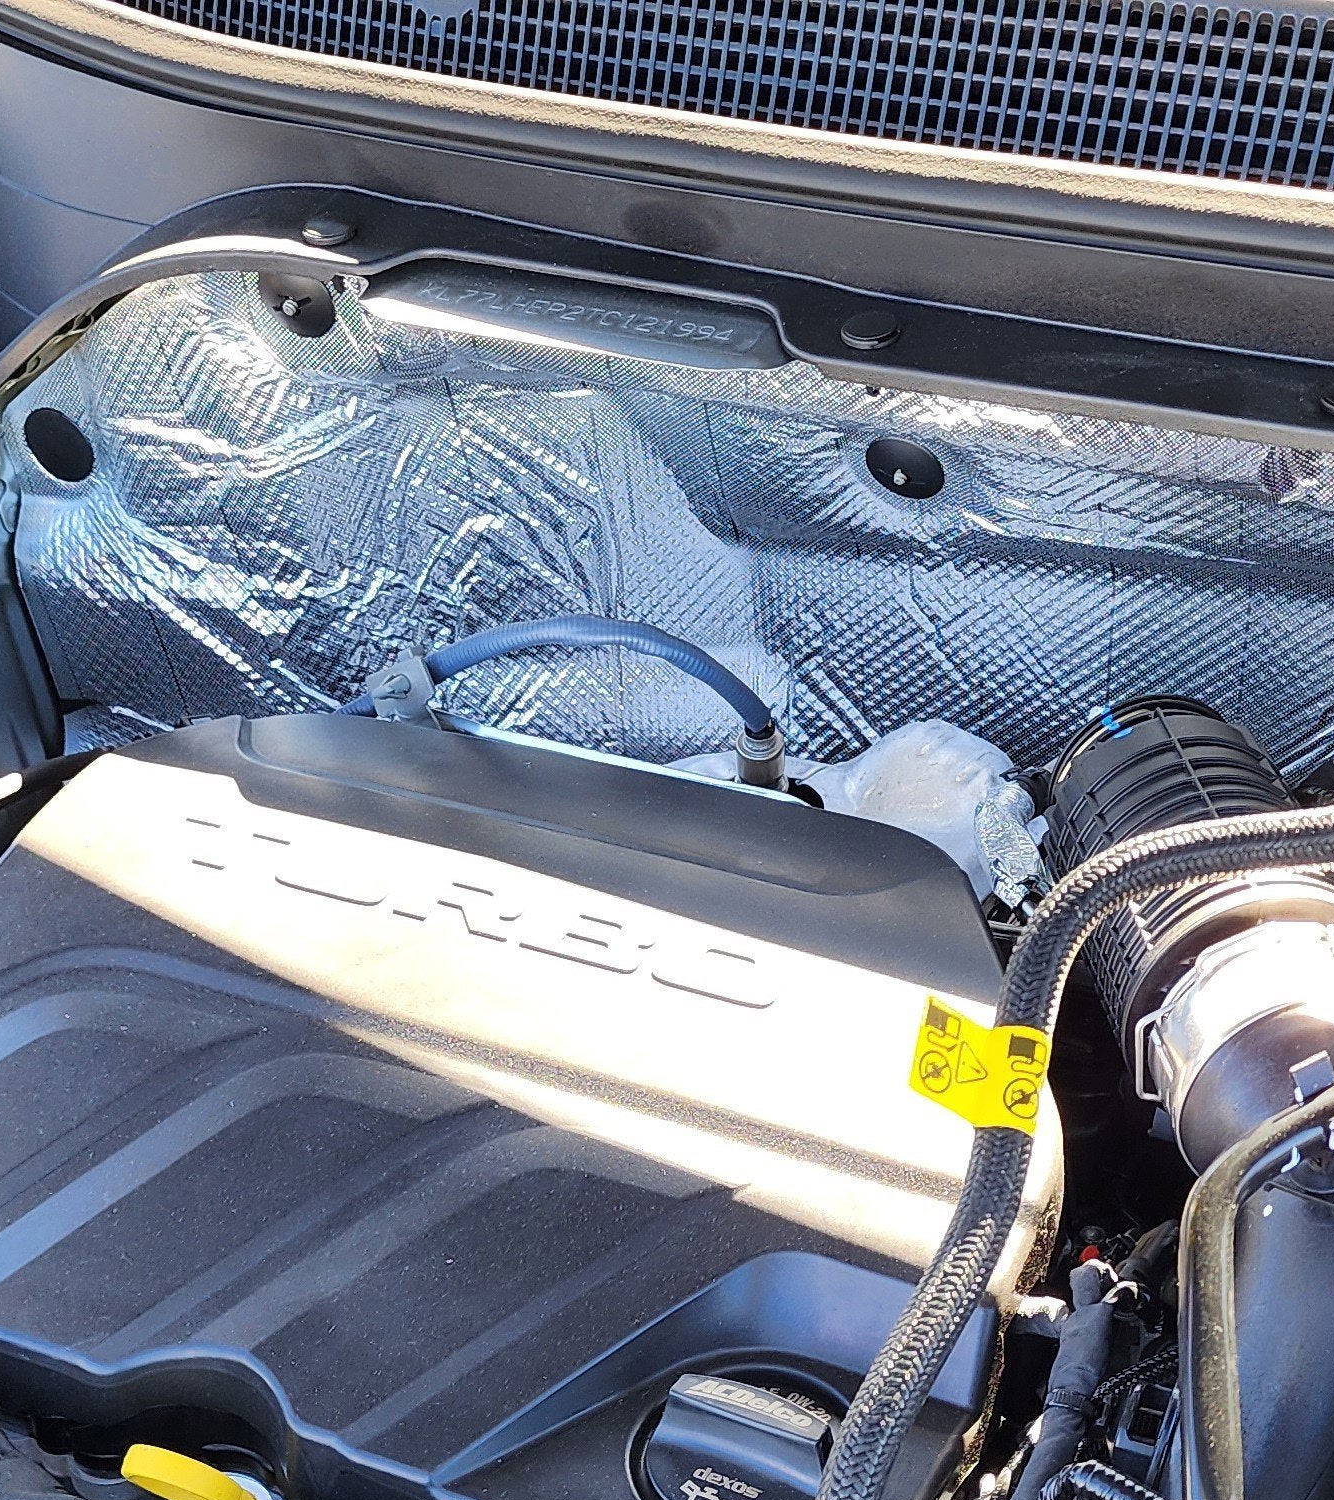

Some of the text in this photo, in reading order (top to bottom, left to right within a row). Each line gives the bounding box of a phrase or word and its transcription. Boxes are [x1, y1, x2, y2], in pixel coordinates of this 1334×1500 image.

[417, 281, 735, 344] KL77LHEP2TC121994
[184, 816, 776, 1010] TURBO
[690, 1379, 814, 1428] ACDelco
[692, 1467, 764, 1499] dexos
